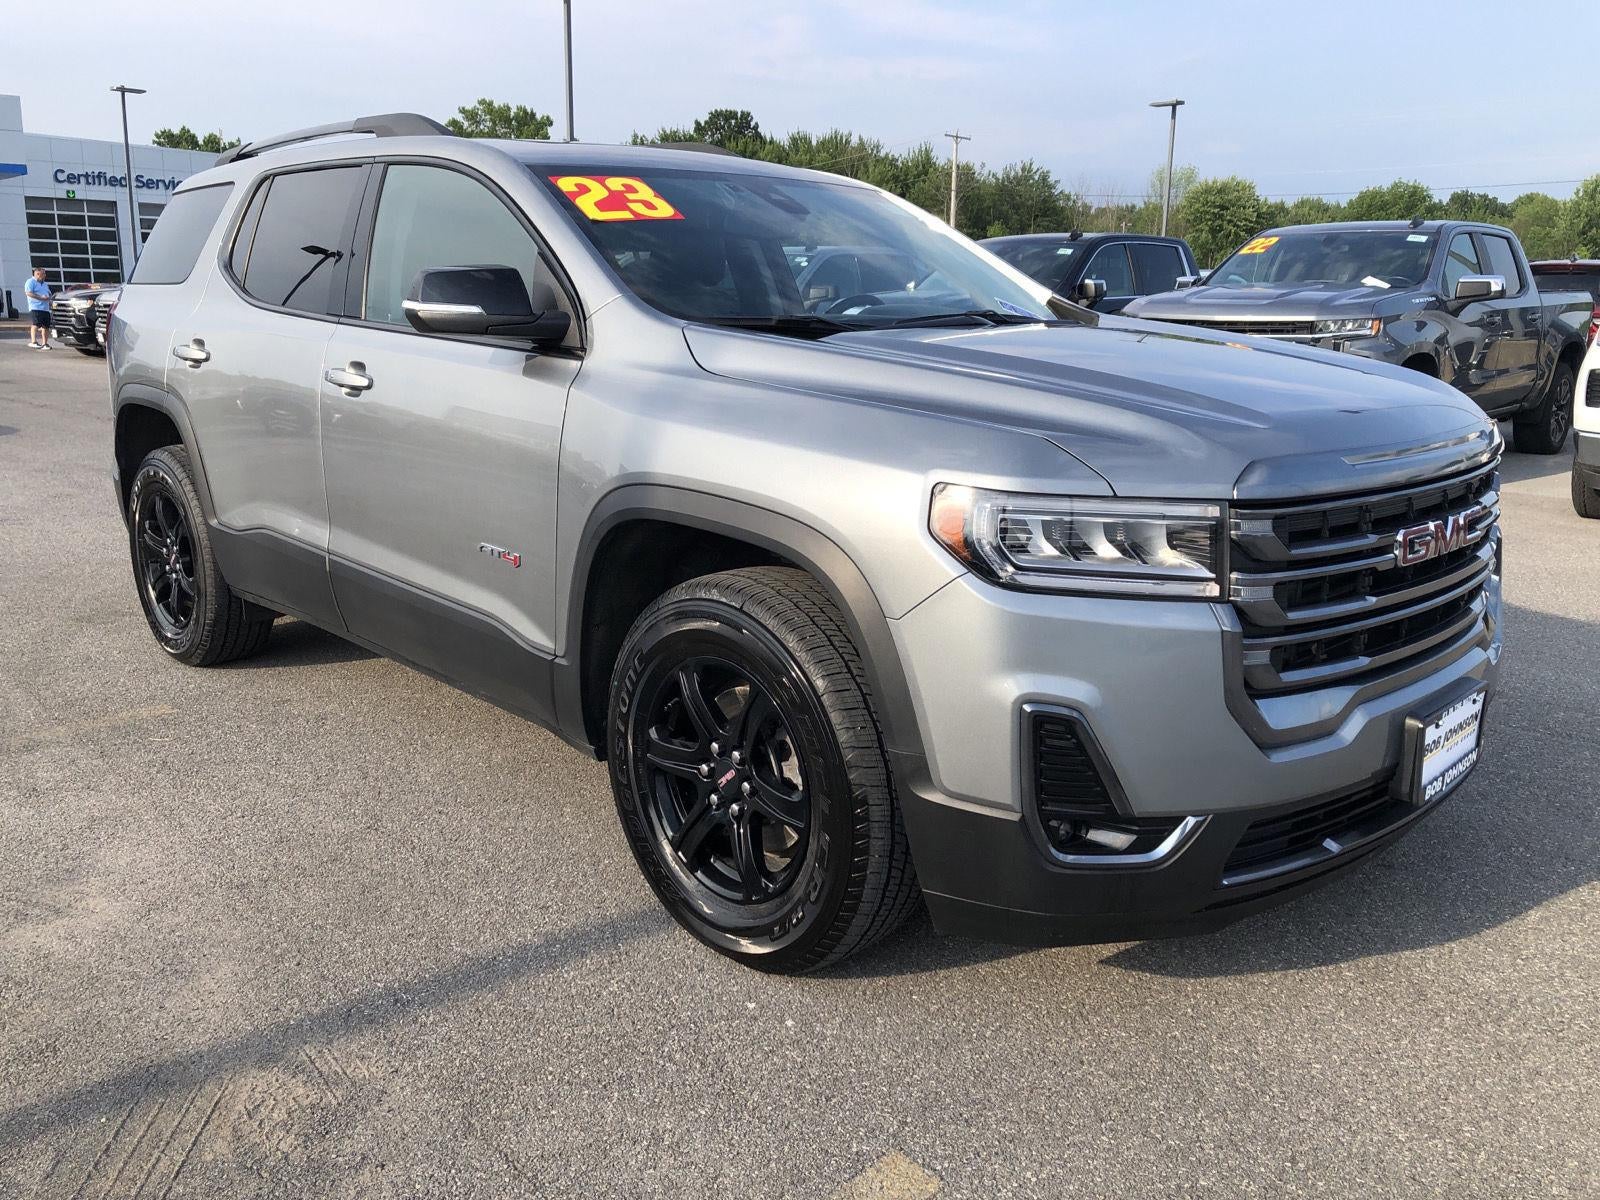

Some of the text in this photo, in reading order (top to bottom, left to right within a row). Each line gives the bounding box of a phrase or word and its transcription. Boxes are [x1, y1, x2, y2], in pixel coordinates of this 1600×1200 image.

[53, 168, 128, 188] Certified
[556, 176, 675, 222] 23
[1239, 236, 1281, 254] 22
[1394, 505, 1492, 566] GMC
[1424, 709, 1481, 756] BOB JOHNSON
[1424, 748, 1479, 801] BOB JOHNSON
